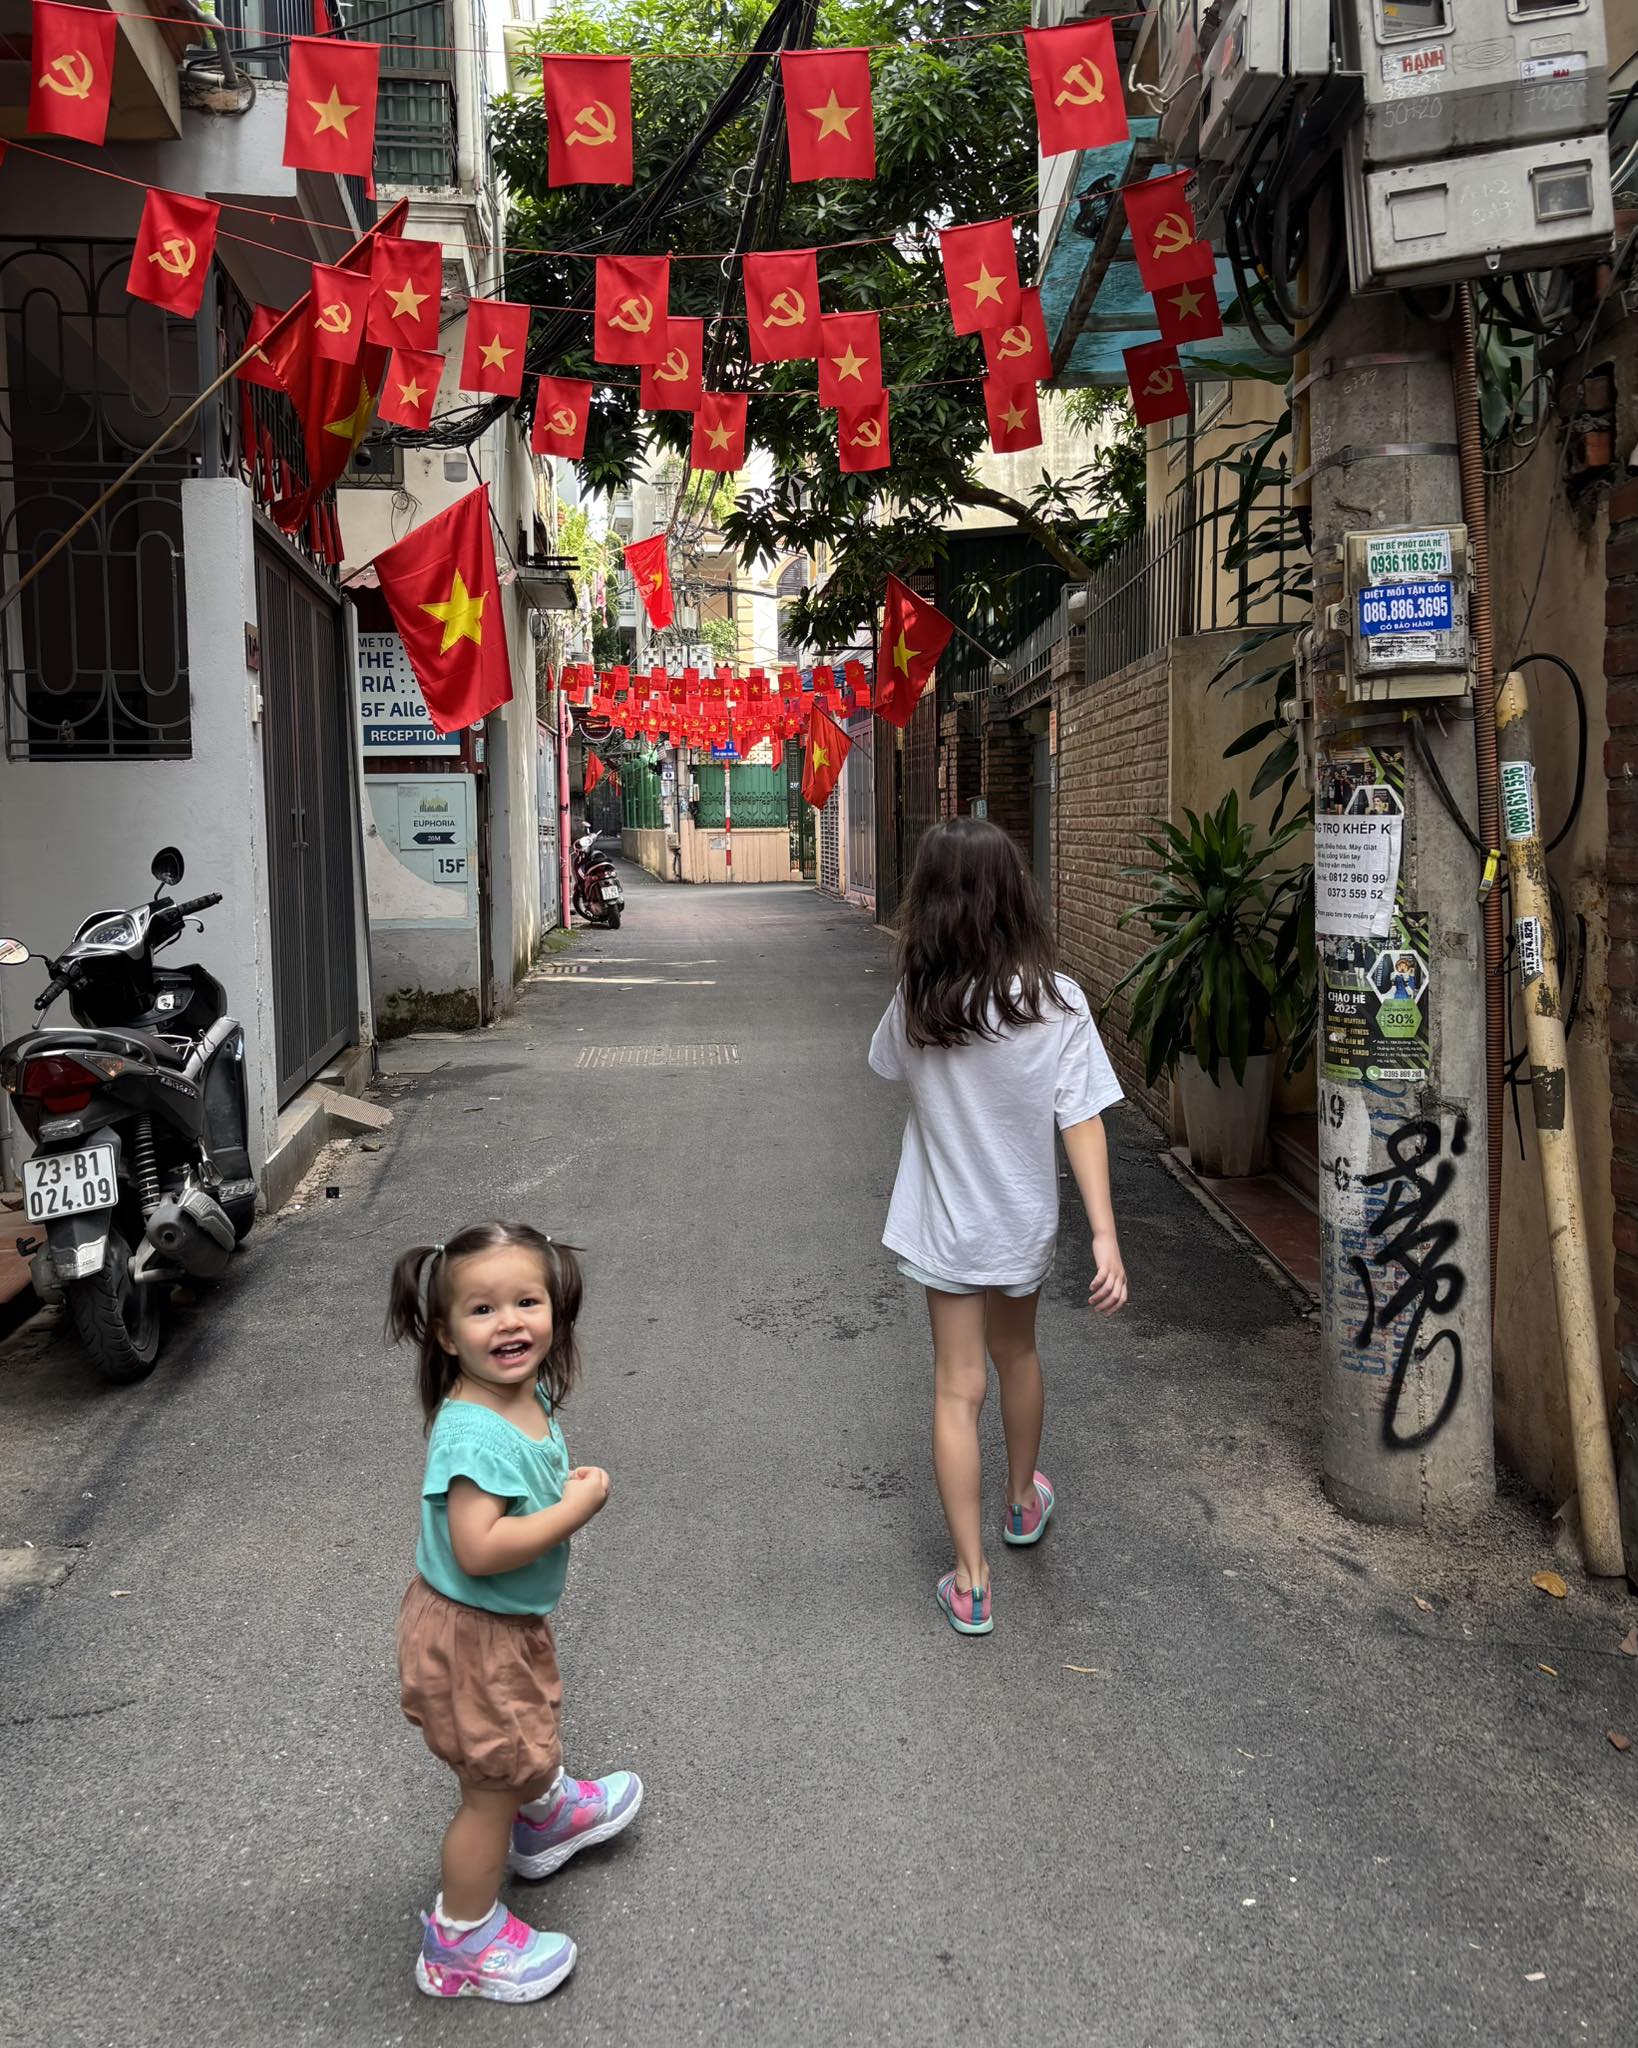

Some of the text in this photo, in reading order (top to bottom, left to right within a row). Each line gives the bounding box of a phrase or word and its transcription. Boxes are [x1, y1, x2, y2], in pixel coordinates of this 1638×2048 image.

[1370, 541, 1386, 551] HÚT
[1397, 539, 1417, 549] PHỐT
[1370, 552, 1442, 574] 0936.118.637
[1364, 582, 1447, 600] DIỆT MỐI TẬN GỐC
[1363, 596, 1448, 623] 086.886.3695
[1380, 619, 1434, 630] CÓ BẢO HÀNH
[378, 637, 394, 648] TO
[359, 652, 395, 669] THE
[362, 676, 396, 692] RIA
[361, 702, 427, 718] 5F Alle
[371, 730, 447, 741] RECEPTION
[1503, 766, 1531, 835] 0988.631.556
[413, 820, 456, 828] EUPHORIA
[1323, 823, 1340, 836] TRỌ
[1343, 820, 1377, 834] KHÉP
[1351, 853, 1361, 861] tay
[438, 859, 465, 873] 15F
[1329, 872, 1348, 883] 0812
[1351, 873, 1369, 883] 960
[1372, 874, 1386, 884] 99
[1328, 888, 1384, 900] 0373 559 52
[1334, 1003, 1357, 1014] 2025
[1387, 1013, 1415, 1024] 30%
[35, 1151, 100, 1187] 23-B1
[30, 1178, 111, 1217] 024.09
